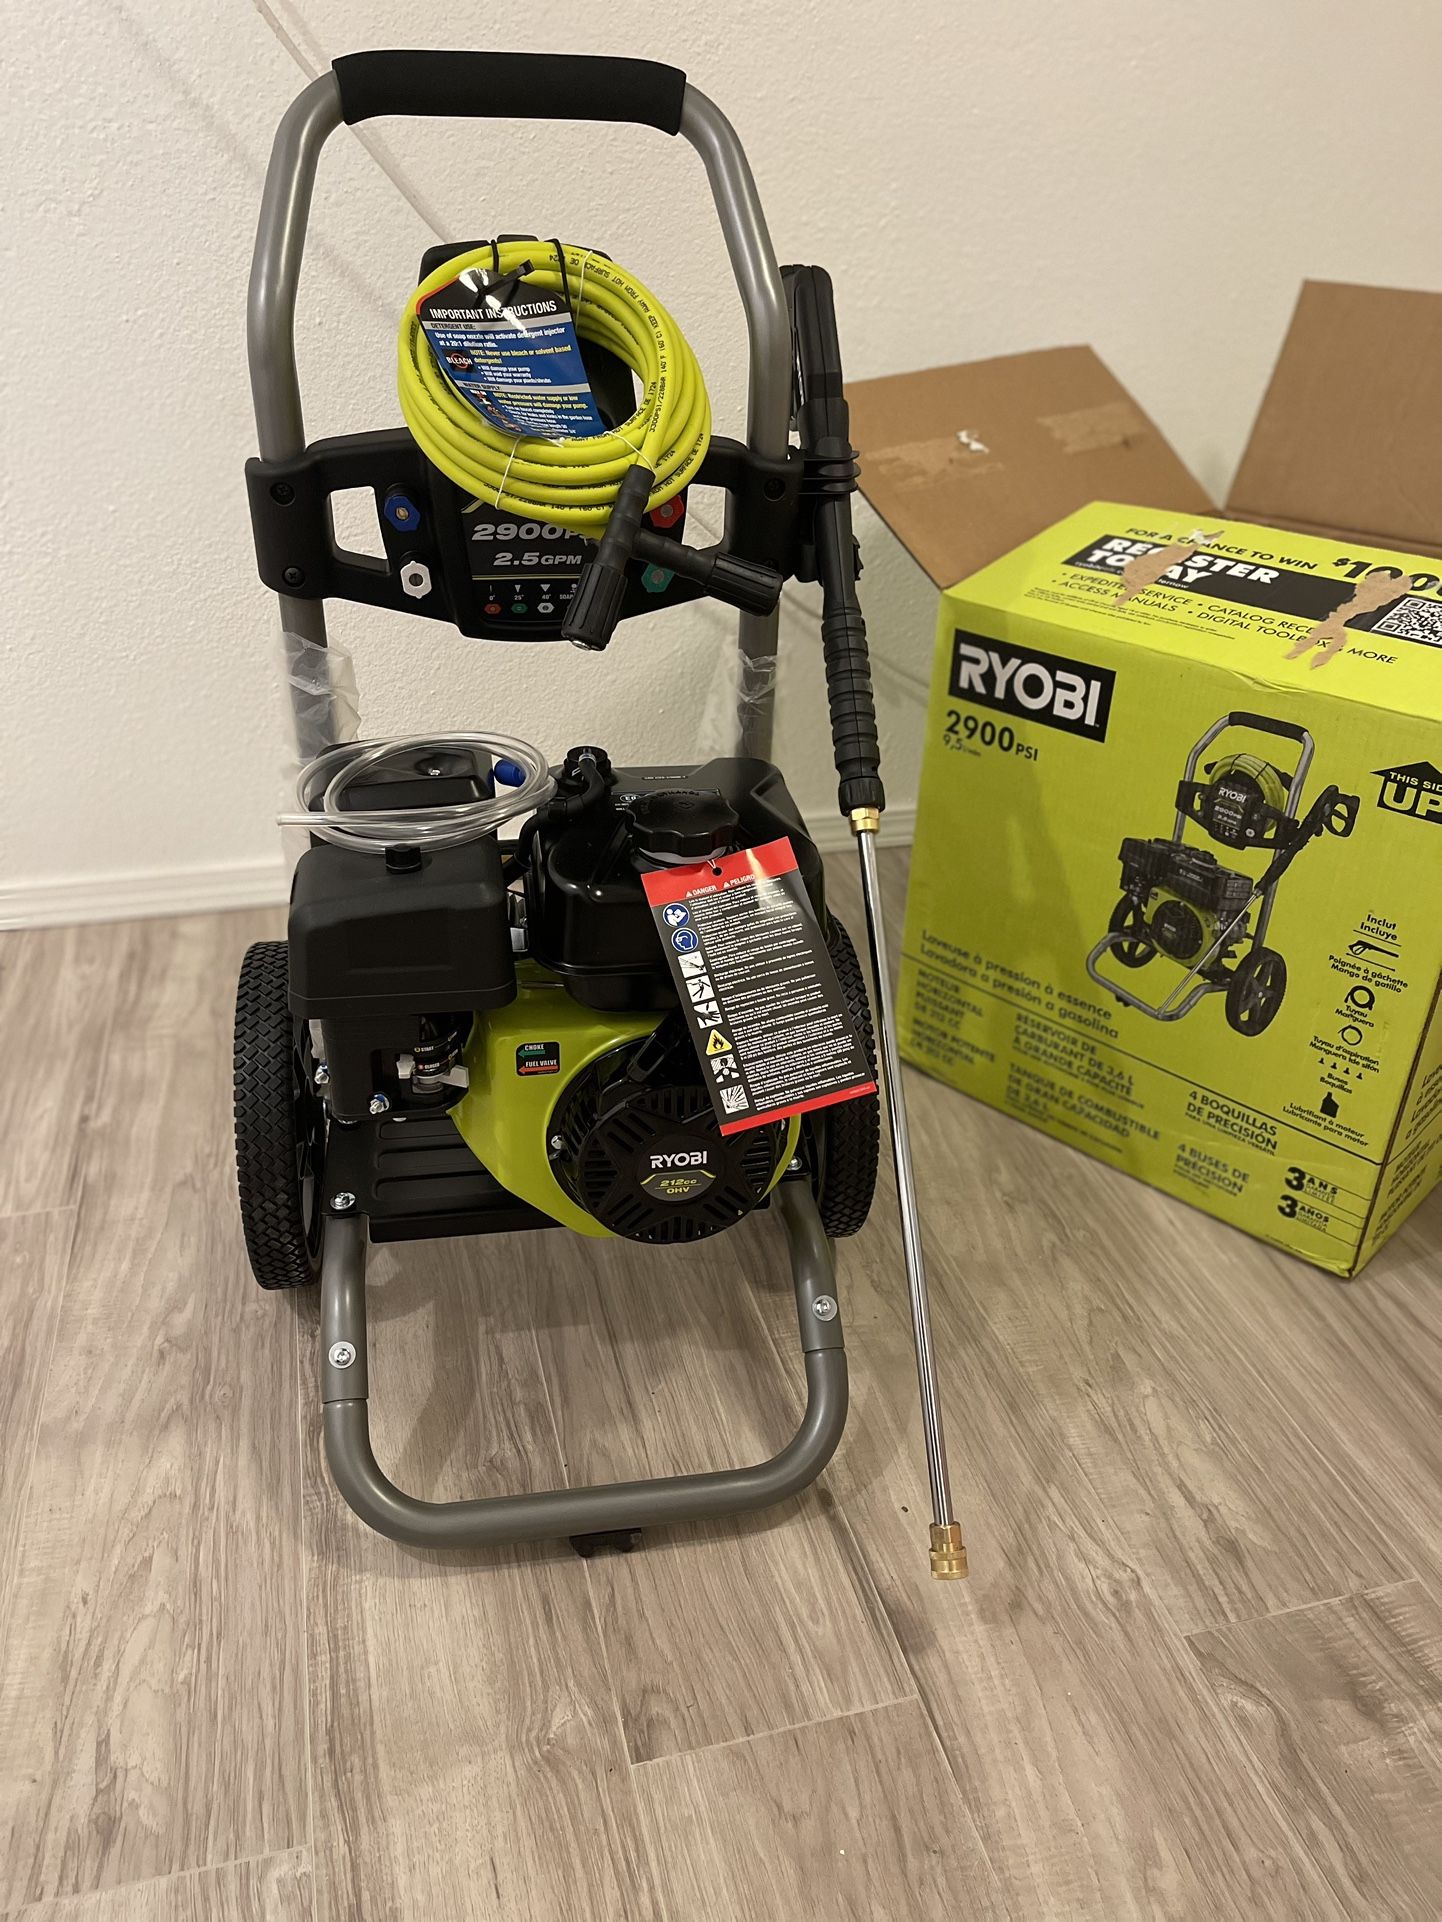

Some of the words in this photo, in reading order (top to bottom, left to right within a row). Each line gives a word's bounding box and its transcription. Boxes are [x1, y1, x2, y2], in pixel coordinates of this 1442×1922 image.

[611, 276, 625, 288] HOT
[624, 285, 639, 300] FROM
[429, 307, 485, 320] IMPORTANT
[430, 322, 462, 330] DETERGENT
[543, 326, 566, 338] injector
[445, 356, 473, 366] BLEACH
[1125, 527, 1158, 538] FOR
[1159, 533, 1174, 541] A
[1250, 549, 1275, 561] TO
[1278, 556, 1319, 570] WIN
[1087, 549, 1212, 584] TOAY
[1101, 538, 1281, 585] RESTER
[1069, 573, 1128, 591] EXPEDITE
[1140, 587, 1195, 606] SERVICE
[1207, 603, 1276, 625] CATALOG
[1058, 581, 1111, 595] ACCESS
[1111, 591, 1179, 612] MNUALS
[1196, 611, 1252, 632] DIGITAL
[1346, 646, 1399, 665] MORE
[958, 642, 1102, 727] RYOBI
[1389, 771, 1419, 786] THIS
[1218, 786, 1247, 804] RYOBI
[1383, 781, 1442, 816] UP
[692, 885, 717, 896] DANGER
[729, 874, 757, 887] PELIGRO
[1360, 922, 1398, 941] Incluye
[1366, 914, 1397, 931] Inclut
[1328, 954, 1362, 973] Poignée
[1371, 970, 1409, 989] gâchette
[1330, 963, 1361, 980] Mango
[1361, 973, 1373, 984] de
[1374, 977, 1403, 994] gatillo
[985, 958, 1041, 991] pression
[1057, 990, 1112, 1020] essence
[1058, 1005, 1119, 1040] gasolina
[1345, 1004, 1369, 1019] Tuyau
[524, 1043, 545, 1051] CHOKE
[525, 1060, 539, 1068] FUEL
[539, 1059, 557, 1067] VALVE
[1188, 1090, 1198, 1101] 4
[1200, 1094, 1278, 1136] BOQUILLAS
[1186, 1101, 1204, 1117] DE
[1206, 1112, 1278, 1150] PRECISIÓN
[649, 1150, 708, 1169] RYOBI
[1283, 1165, 1307, 1192] 3
[666, 1186, 690, 1194] OHV
[1277, 1193, 1299, 1219] 3
